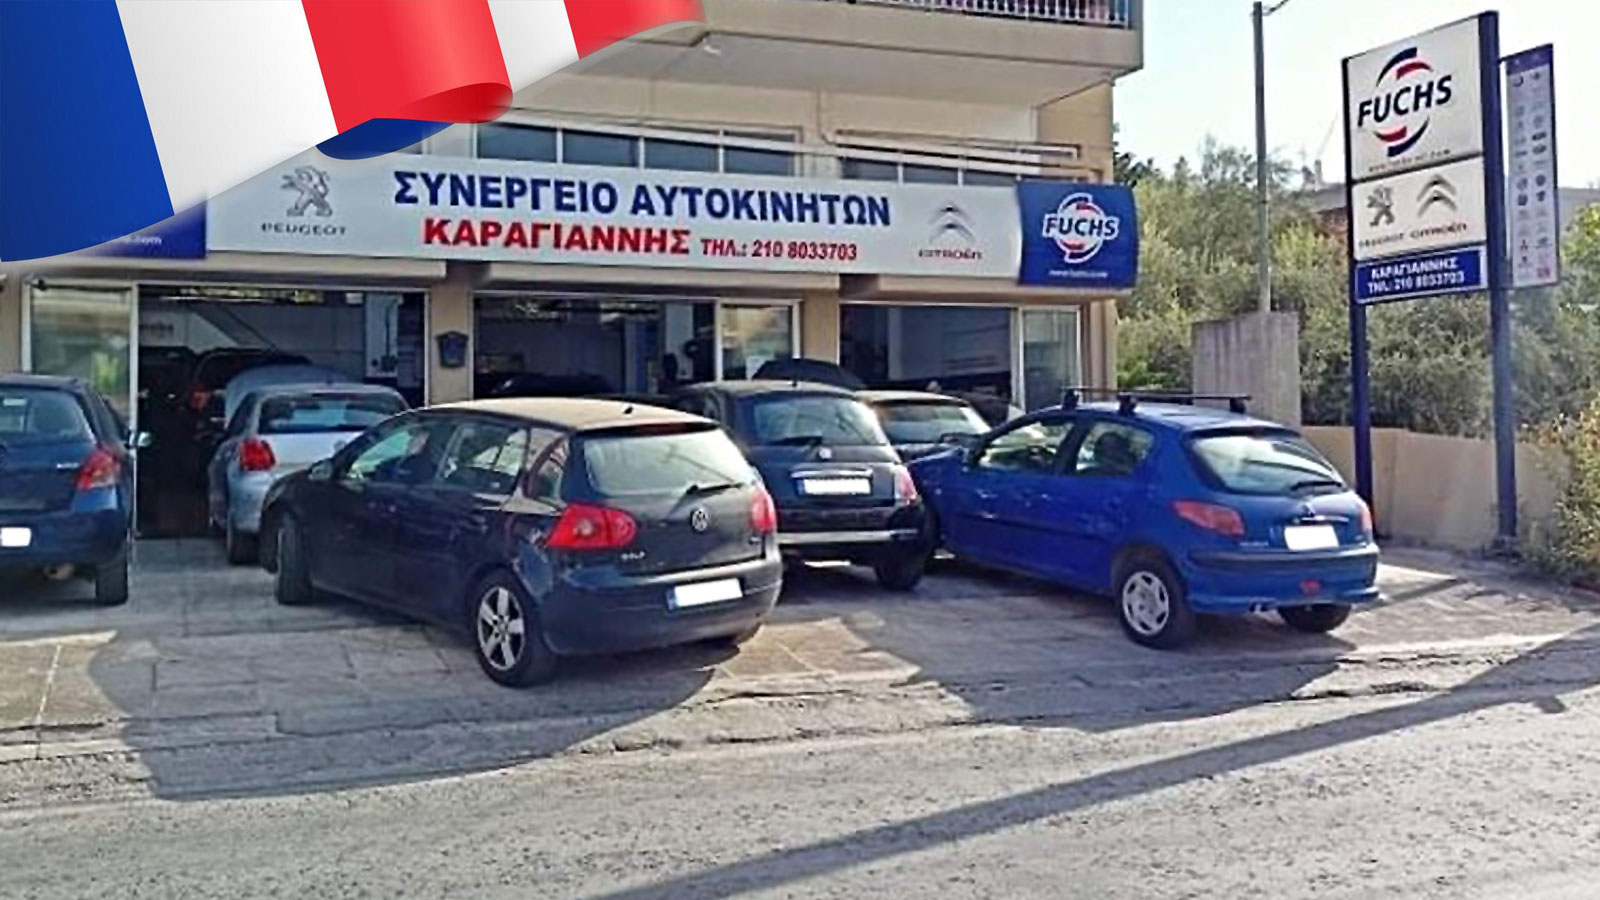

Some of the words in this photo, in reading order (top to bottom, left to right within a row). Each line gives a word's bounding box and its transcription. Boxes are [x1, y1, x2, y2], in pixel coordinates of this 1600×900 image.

[1357, 74, 1452, 127] FUCHS
[393, 170, 618, 214] ΣΥΝΕΡΓΕΙΟ
[630, 184, 891, 226] ΑΥΤΟΚΙΝΗΤΩΝ
[261, 222, 346, 236] PEUGEOT
[423, 218, 691, 255] ΚΑΡΑΓΙΑΝΝΗΣ
[751, 239, 784, 257] 210
[787, 242, 858, 261] 8033703
[1044, 216, 1118, 239] FUCHS
